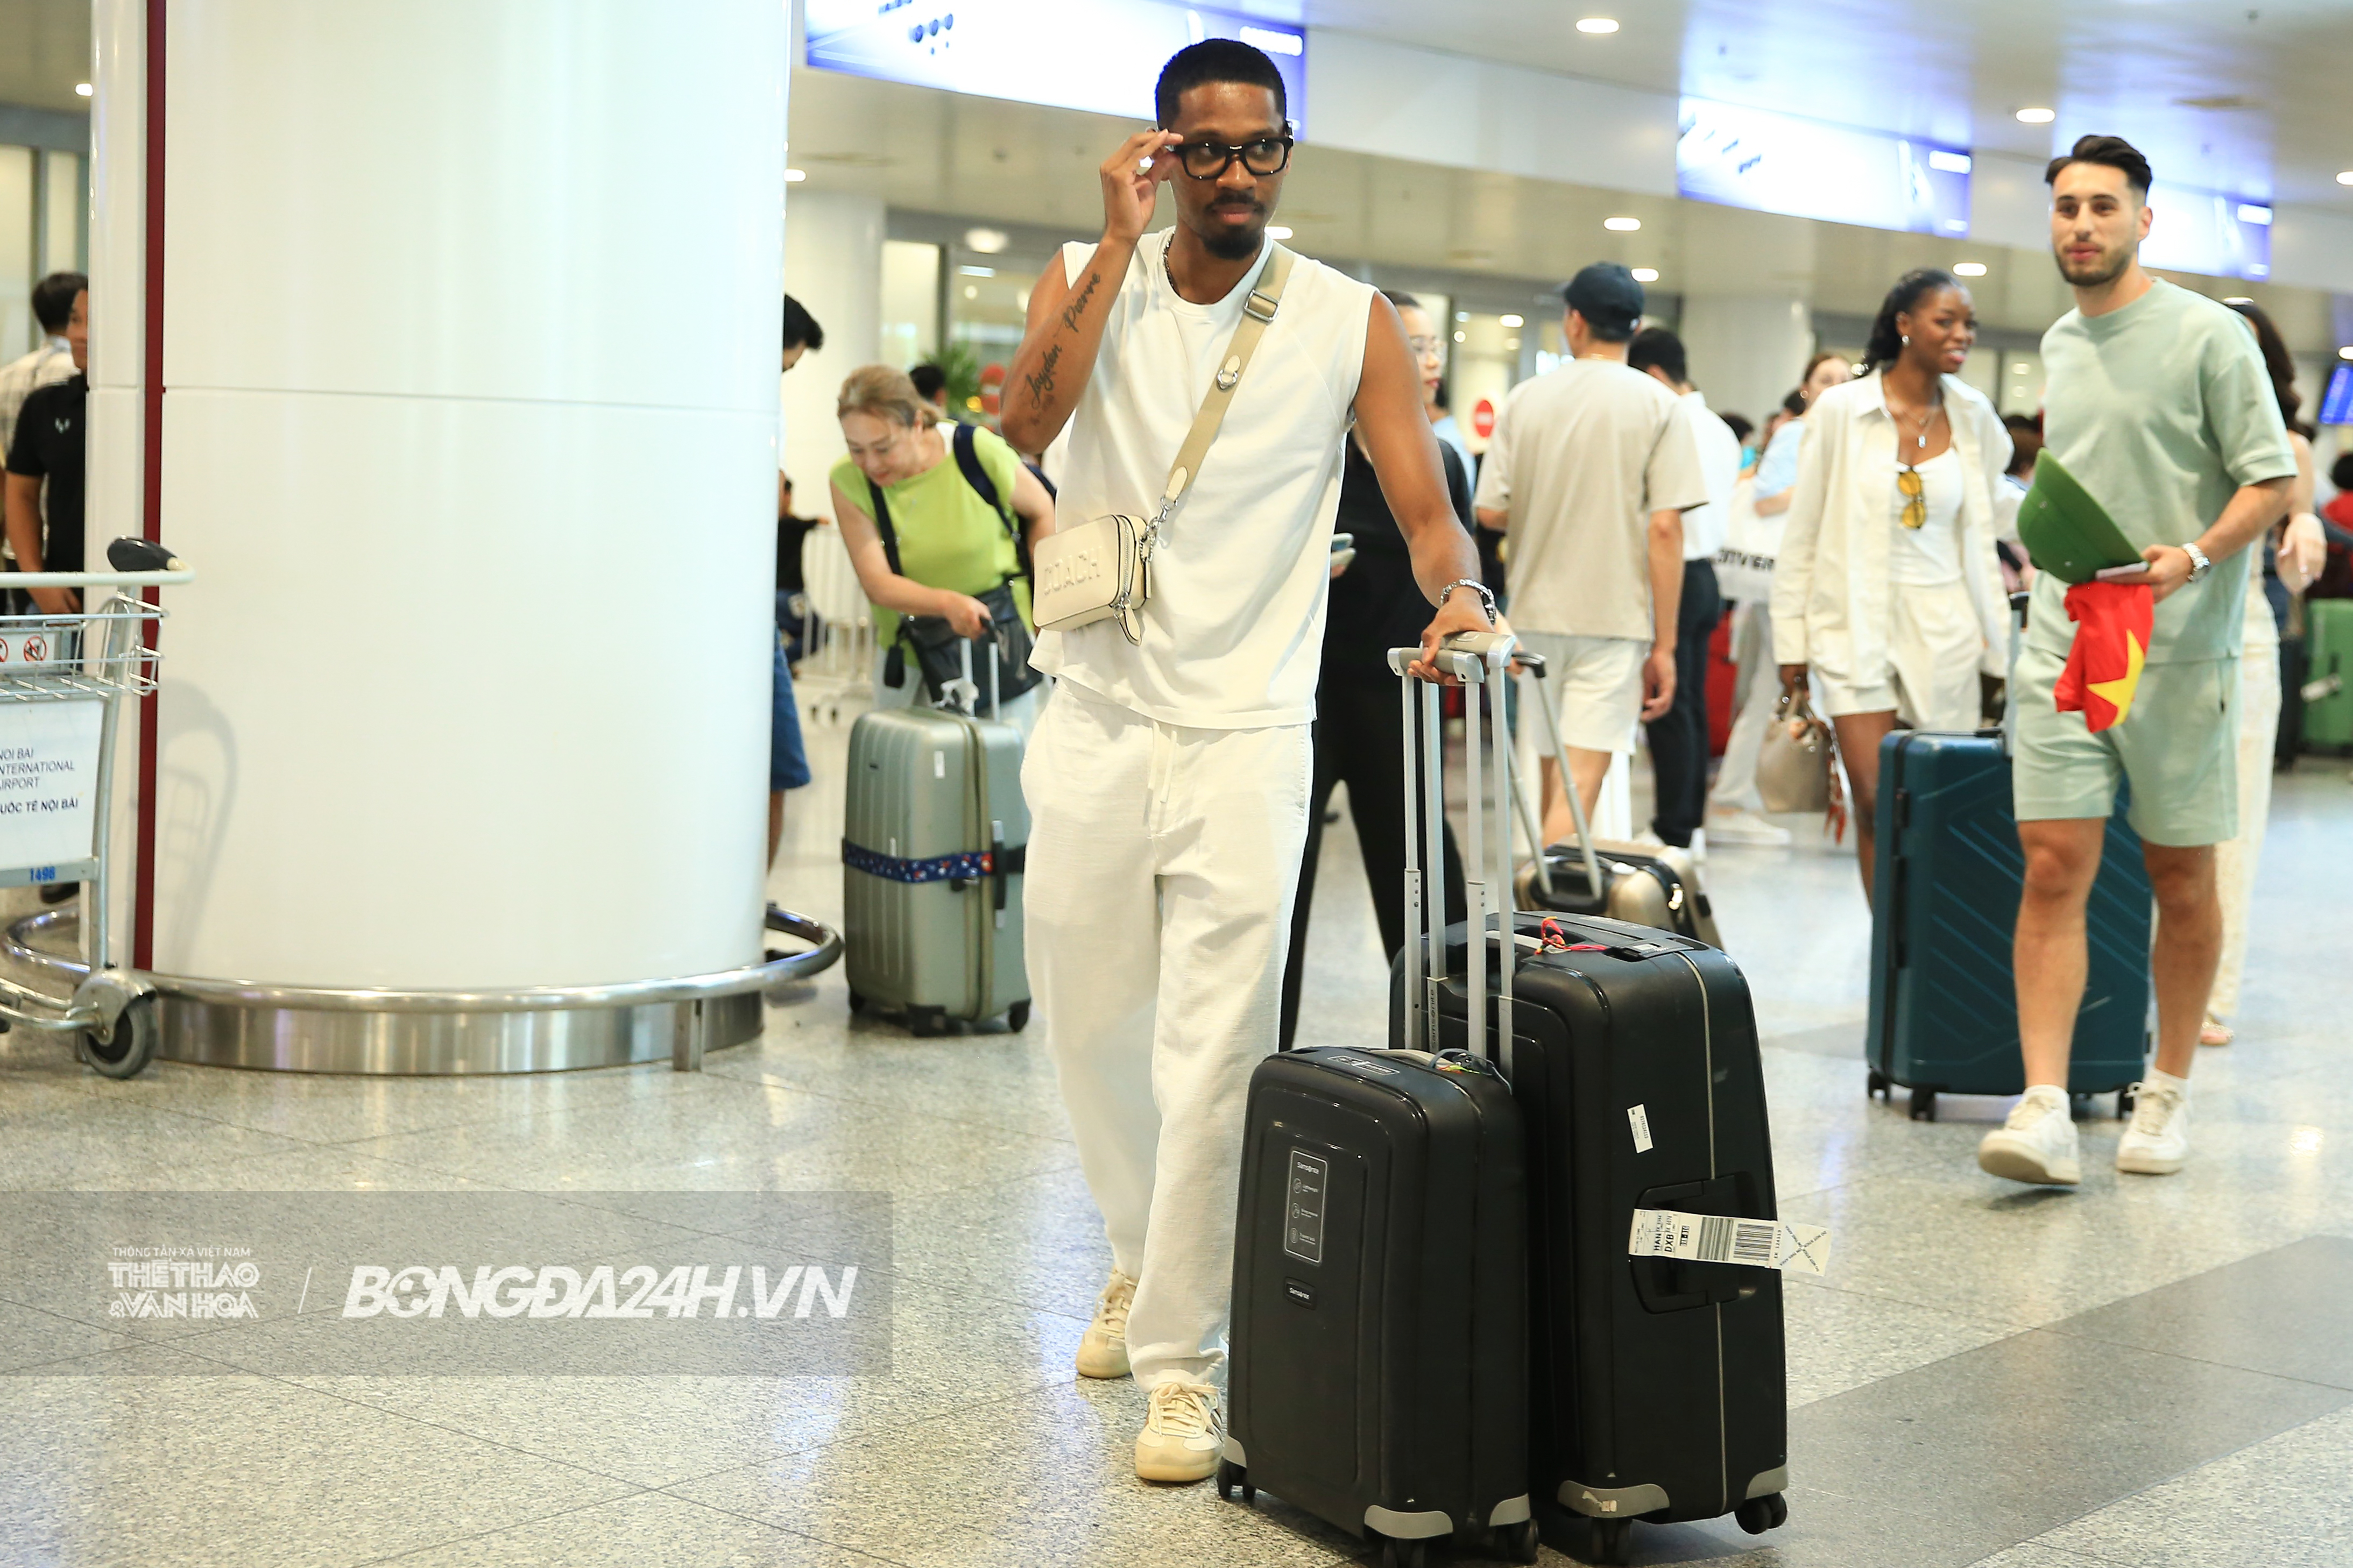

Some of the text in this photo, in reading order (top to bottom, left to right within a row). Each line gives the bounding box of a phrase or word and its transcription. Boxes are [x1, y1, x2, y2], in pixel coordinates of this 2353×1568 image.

[0, 760, 75, 775] NTERNATIONAL
[1654, 1233, 1662, 1251] HAN
[1664, 1234, 1674, 1253] DXB
